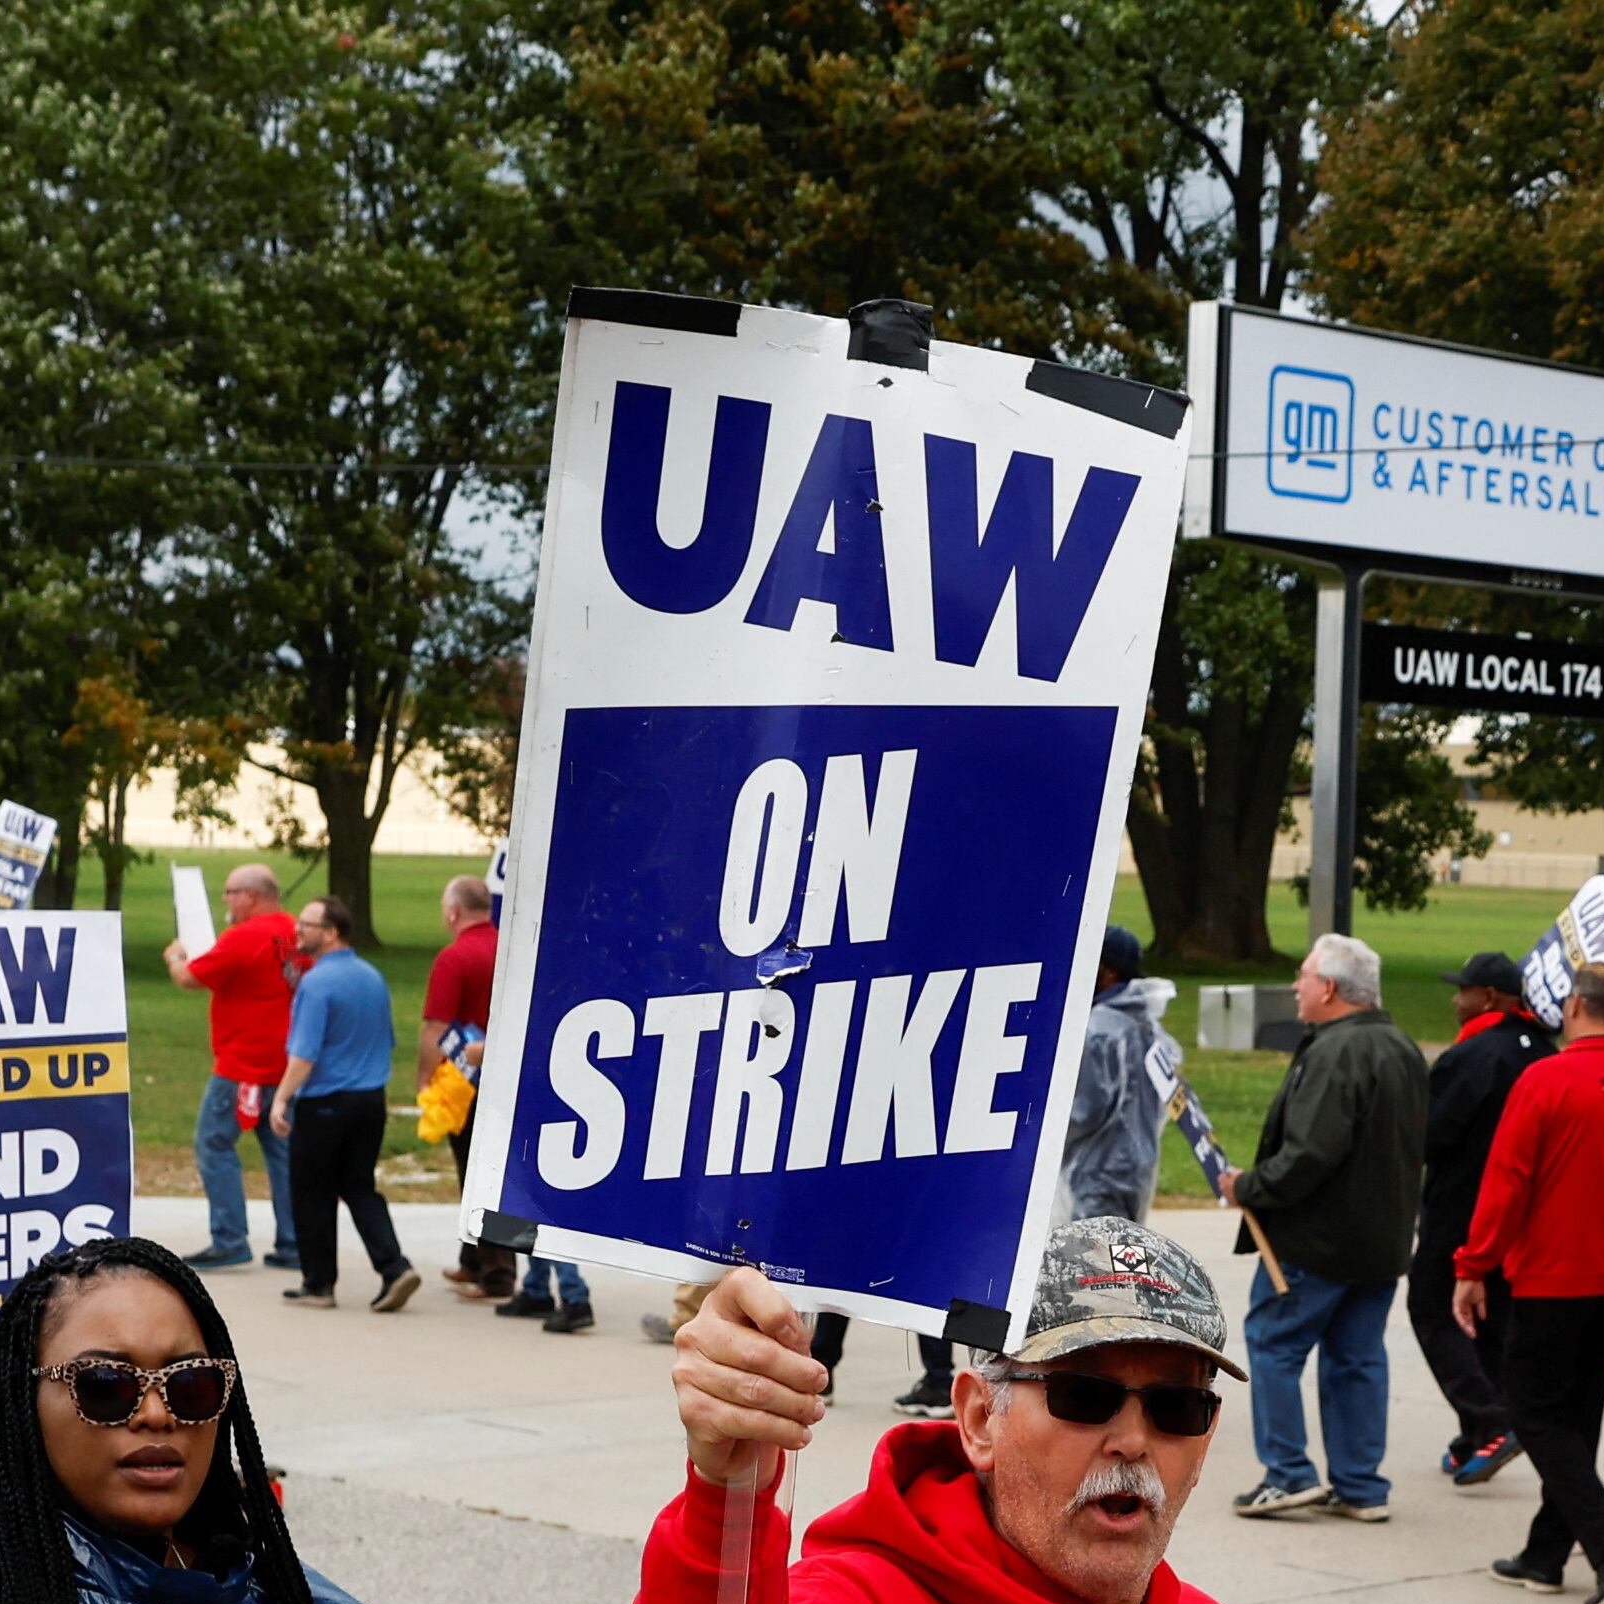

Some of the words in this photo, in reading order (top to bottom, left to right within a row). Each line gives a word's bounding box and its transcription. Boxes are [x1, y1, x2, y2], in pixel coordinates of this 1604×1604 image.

[1372, 403, 1574, 467] CUSTOMER
[1372, 450, 1393, 489] &
[601, 379, 1142, 683] UAW
[1394, 646, 1457, 686] UAW
[1465, 653, 1555, 696] LOCAL
[1560, 662, 1603, 700] 174
[717, 748, 919, 958] ON
[48, 1052, 111, 1088] UP
[537, 961, 1042, 1190] STRIKE
